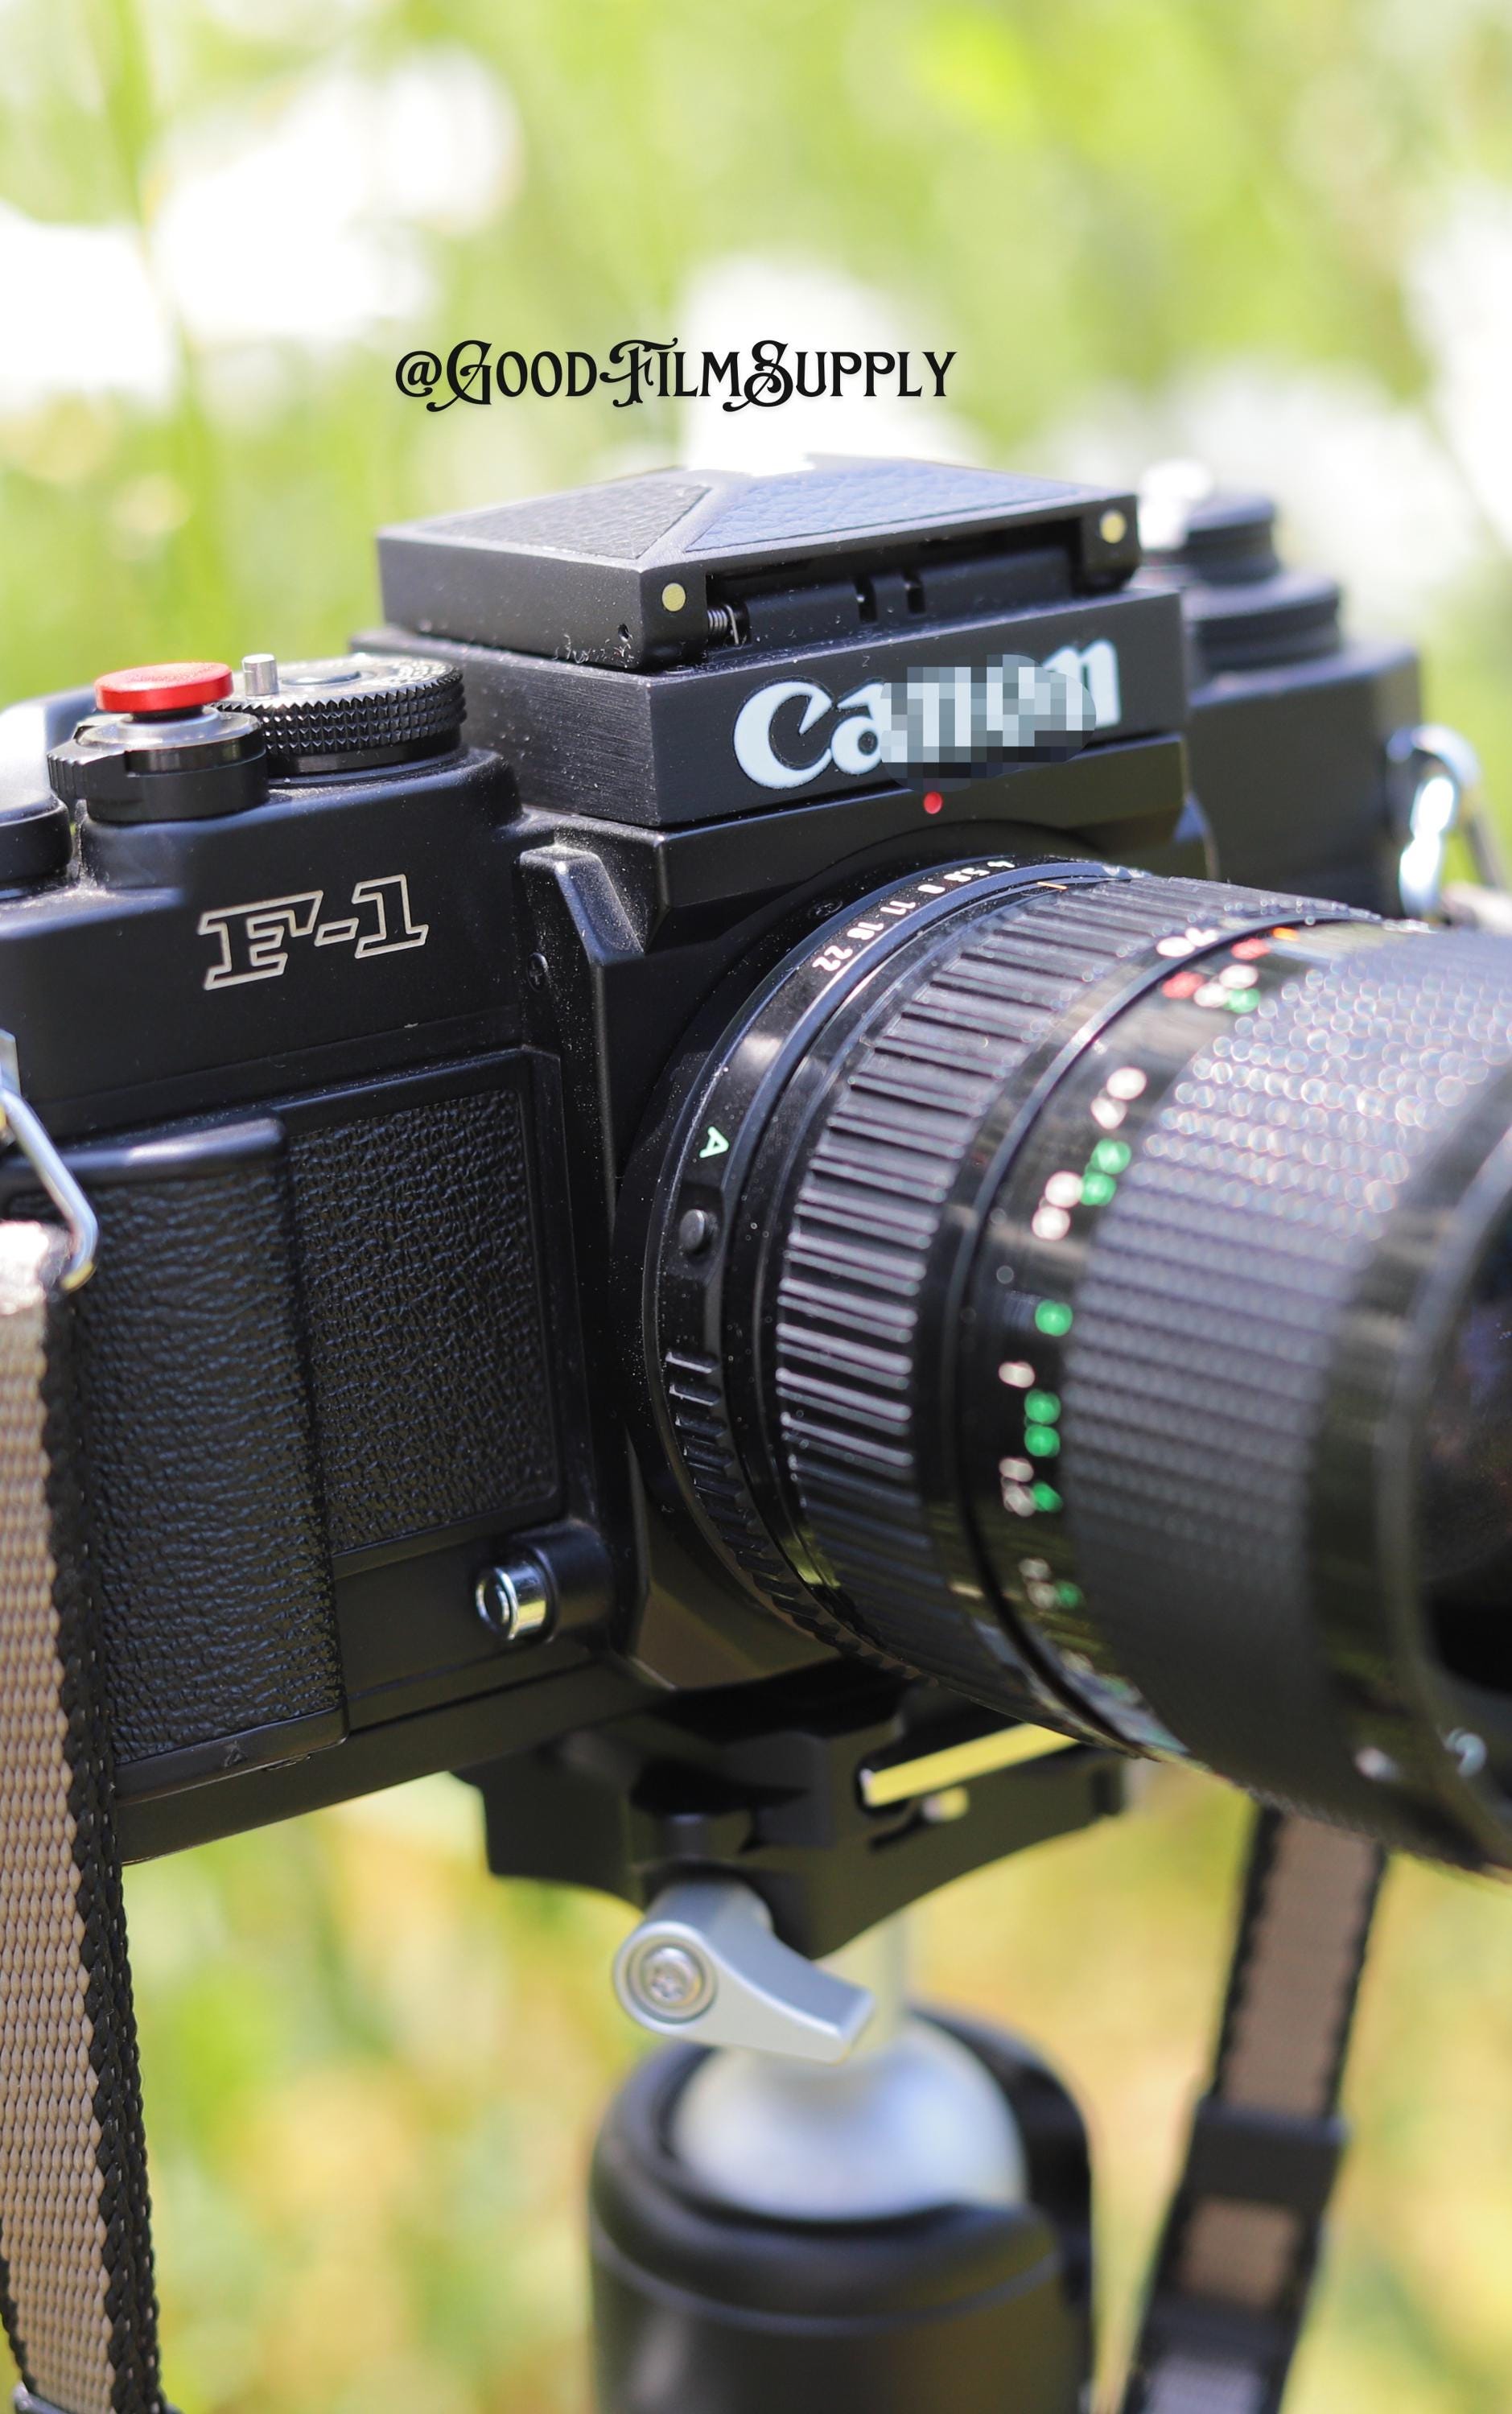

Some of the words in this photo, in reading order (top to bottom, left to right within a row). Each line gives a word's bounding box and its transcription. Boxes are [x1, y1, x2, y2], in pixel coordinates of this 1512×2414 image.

[733, 639, 1122, 789] Can
[880, 900, 917, 916] 11
[197, 873, 429, 991] F-1
[811, 945, 854, 972] 22
[699, 1126, 730, 1159] A
